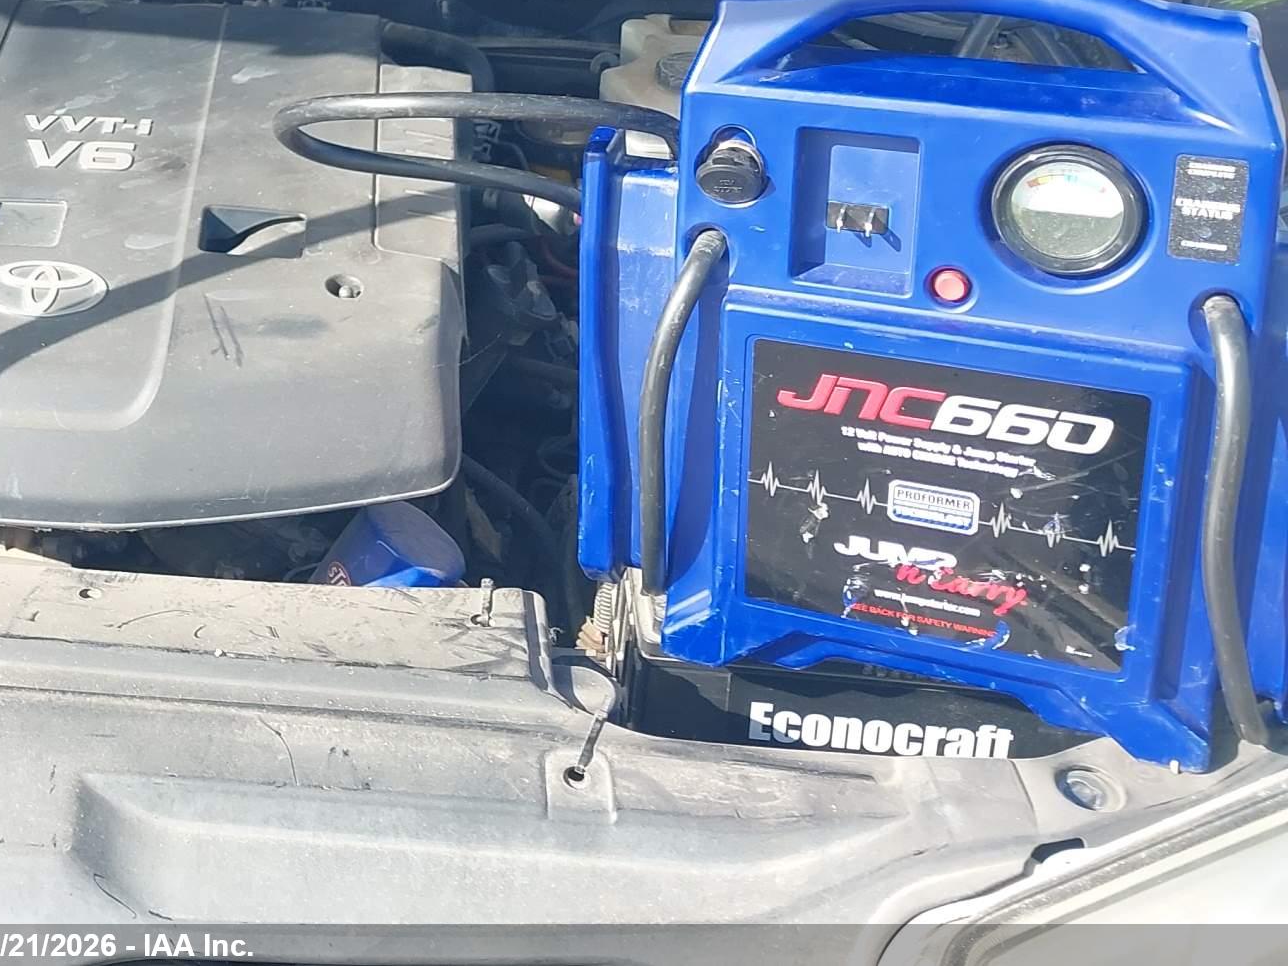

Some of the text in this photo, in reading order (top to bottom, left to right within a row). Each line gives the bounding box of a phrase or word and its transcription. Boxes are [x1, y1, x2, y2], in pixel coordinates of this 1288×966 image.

[27, 139, 137, 171] V6
[1181, 206, 1233, 221] STATUS
[777, 374, 1114, 454] JNC660
[842, 426, 1036, 467] 12 Volt Power Supply & Jump Starter
[897, 488, 971, 511] PROFORMER
[869, 606, 895, 617] BACK
[896, 610, 915, 622] FOR
[916, 614, 952, 629] SAFETY
[748, 701, 1014, 759] Econocraft
